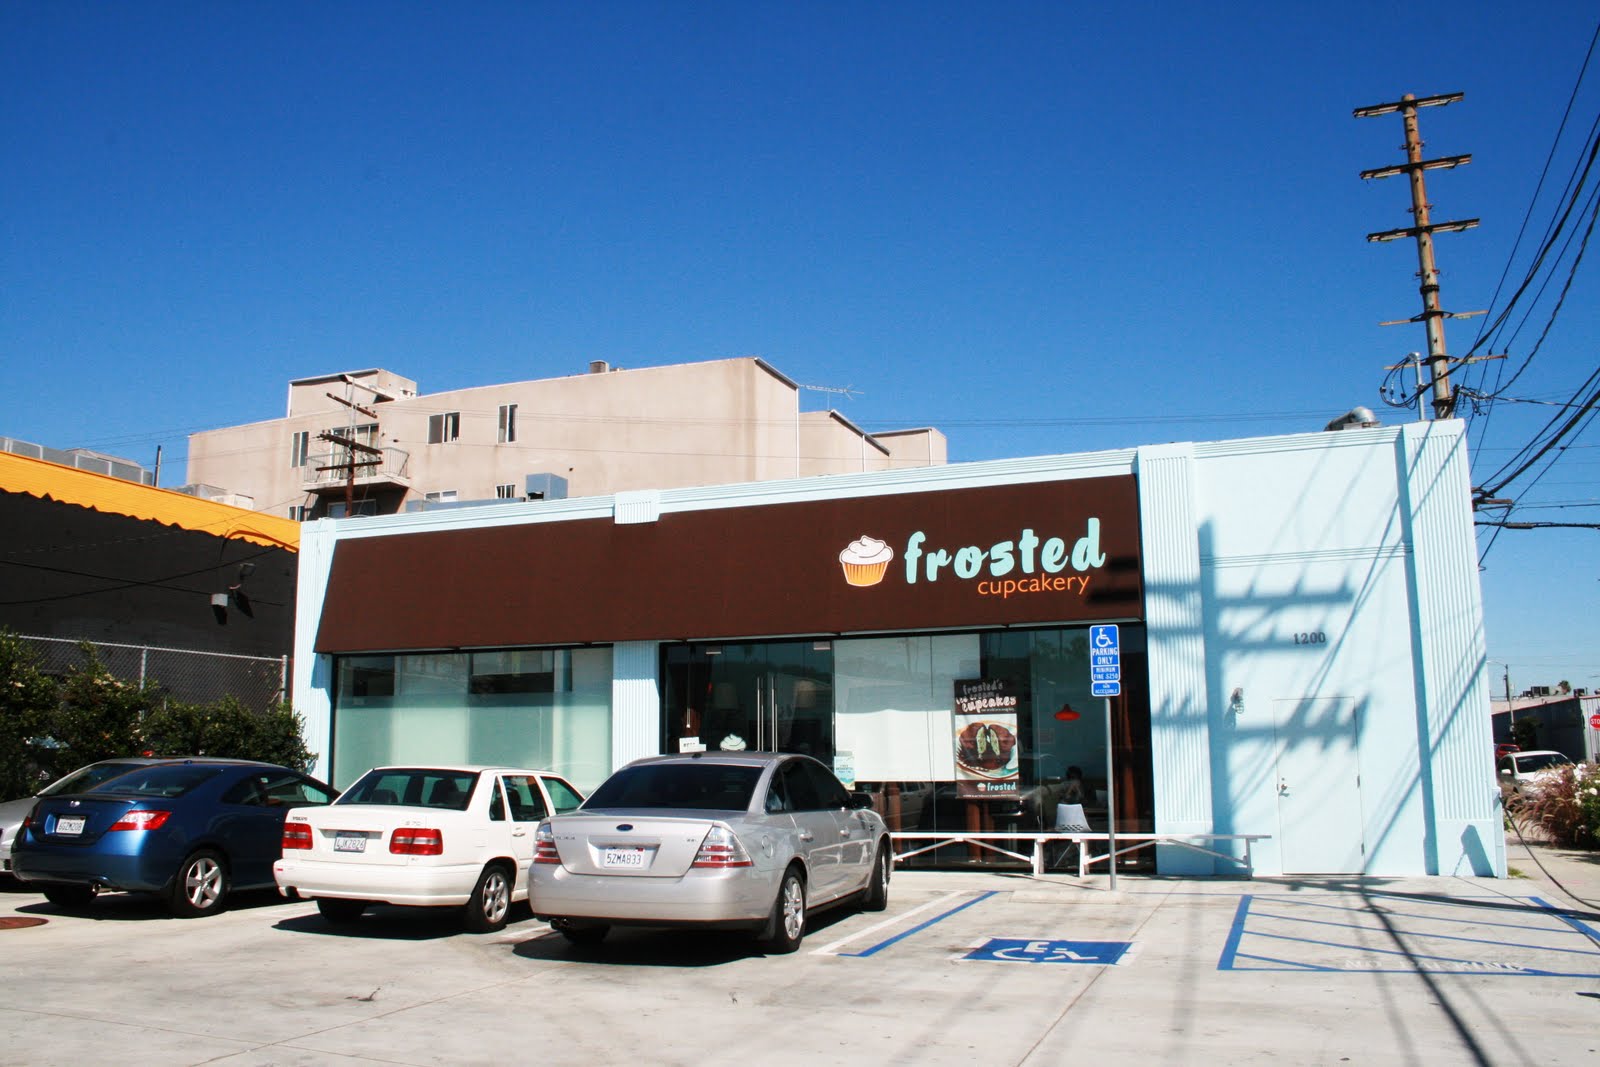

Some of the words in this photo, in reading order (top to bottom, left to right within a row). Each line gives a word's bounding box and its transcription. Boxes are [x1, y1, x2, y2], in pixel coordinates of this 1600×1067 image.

[904, 517, 1106, 584] frosted
[977, 573, 1091, 598] cupcakery
[1293, 631, 1327, 645] 1200
[1092, 647, 1118, 656] PARKING
[1097, 656, 1113, 665] ONLY
[961, 693, 1017, 713] cupcakes
[987, 781, 1016, 791] frosted
[607, 853, 642, 865] 5ZMA833
